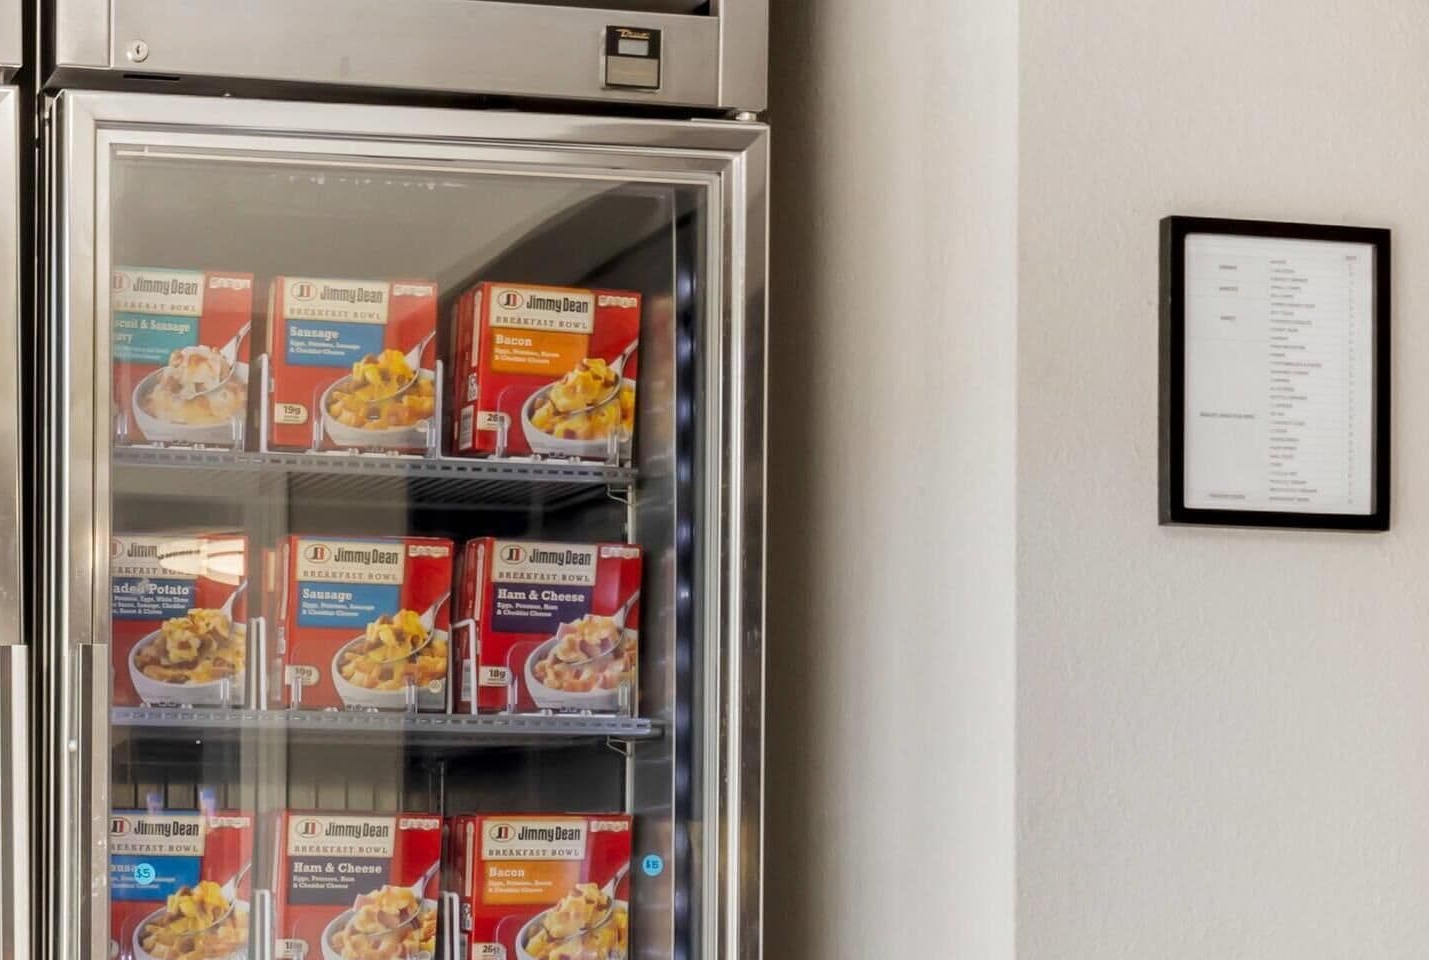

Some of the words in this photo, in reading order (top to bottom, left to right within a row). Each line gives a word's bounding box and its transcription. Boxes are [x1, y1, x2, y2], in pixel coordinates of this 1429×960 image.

[133, 277, 170, 295] Jimmy
[171, 280, 198, 295] Dean
[320, 286, 357, 303] Jimmy
[357, 288, 383, 303] Dean
[526, 295, 562, 313] Jimmy
[563, 297, 589, 313] Dean
[290, 327, 340, 340] Sausage
[496, 334, 533, 347] Bacon
[334, 547, 371, 565] Jimmy
[372, 549, 399, 564] Dean
[529, 549, 565, 566] Jimmy
[566, 551, 591, 566] Dean
[149, 584, 190, 595] Potato
[302, 588, 353, 602] Sausage
[497, 588, 527, 600] Ham
[528, 589, 540, 600] &
[541, 590, 585, 603] Cheese
[489, 669, 506, 679] 18g
[134, 821, 172, 838] Jimmy
[173, 821, 199, 836] Dean
[325, 822, 362, 839] Jimmy
[363, 822, 389, 838] Dean
[518, 826, 554, 843] Jimmy
[555, 826, 580, 841] Dean
[293, 862, 322, 873] Ham
[325, 862, 335, 873] &
[338, 862, 382, 874] Cheese
[646, 859, 659, 870] $5
[136, 868, 151, 880] $5
[488, 867, 525, 877] Bacon
